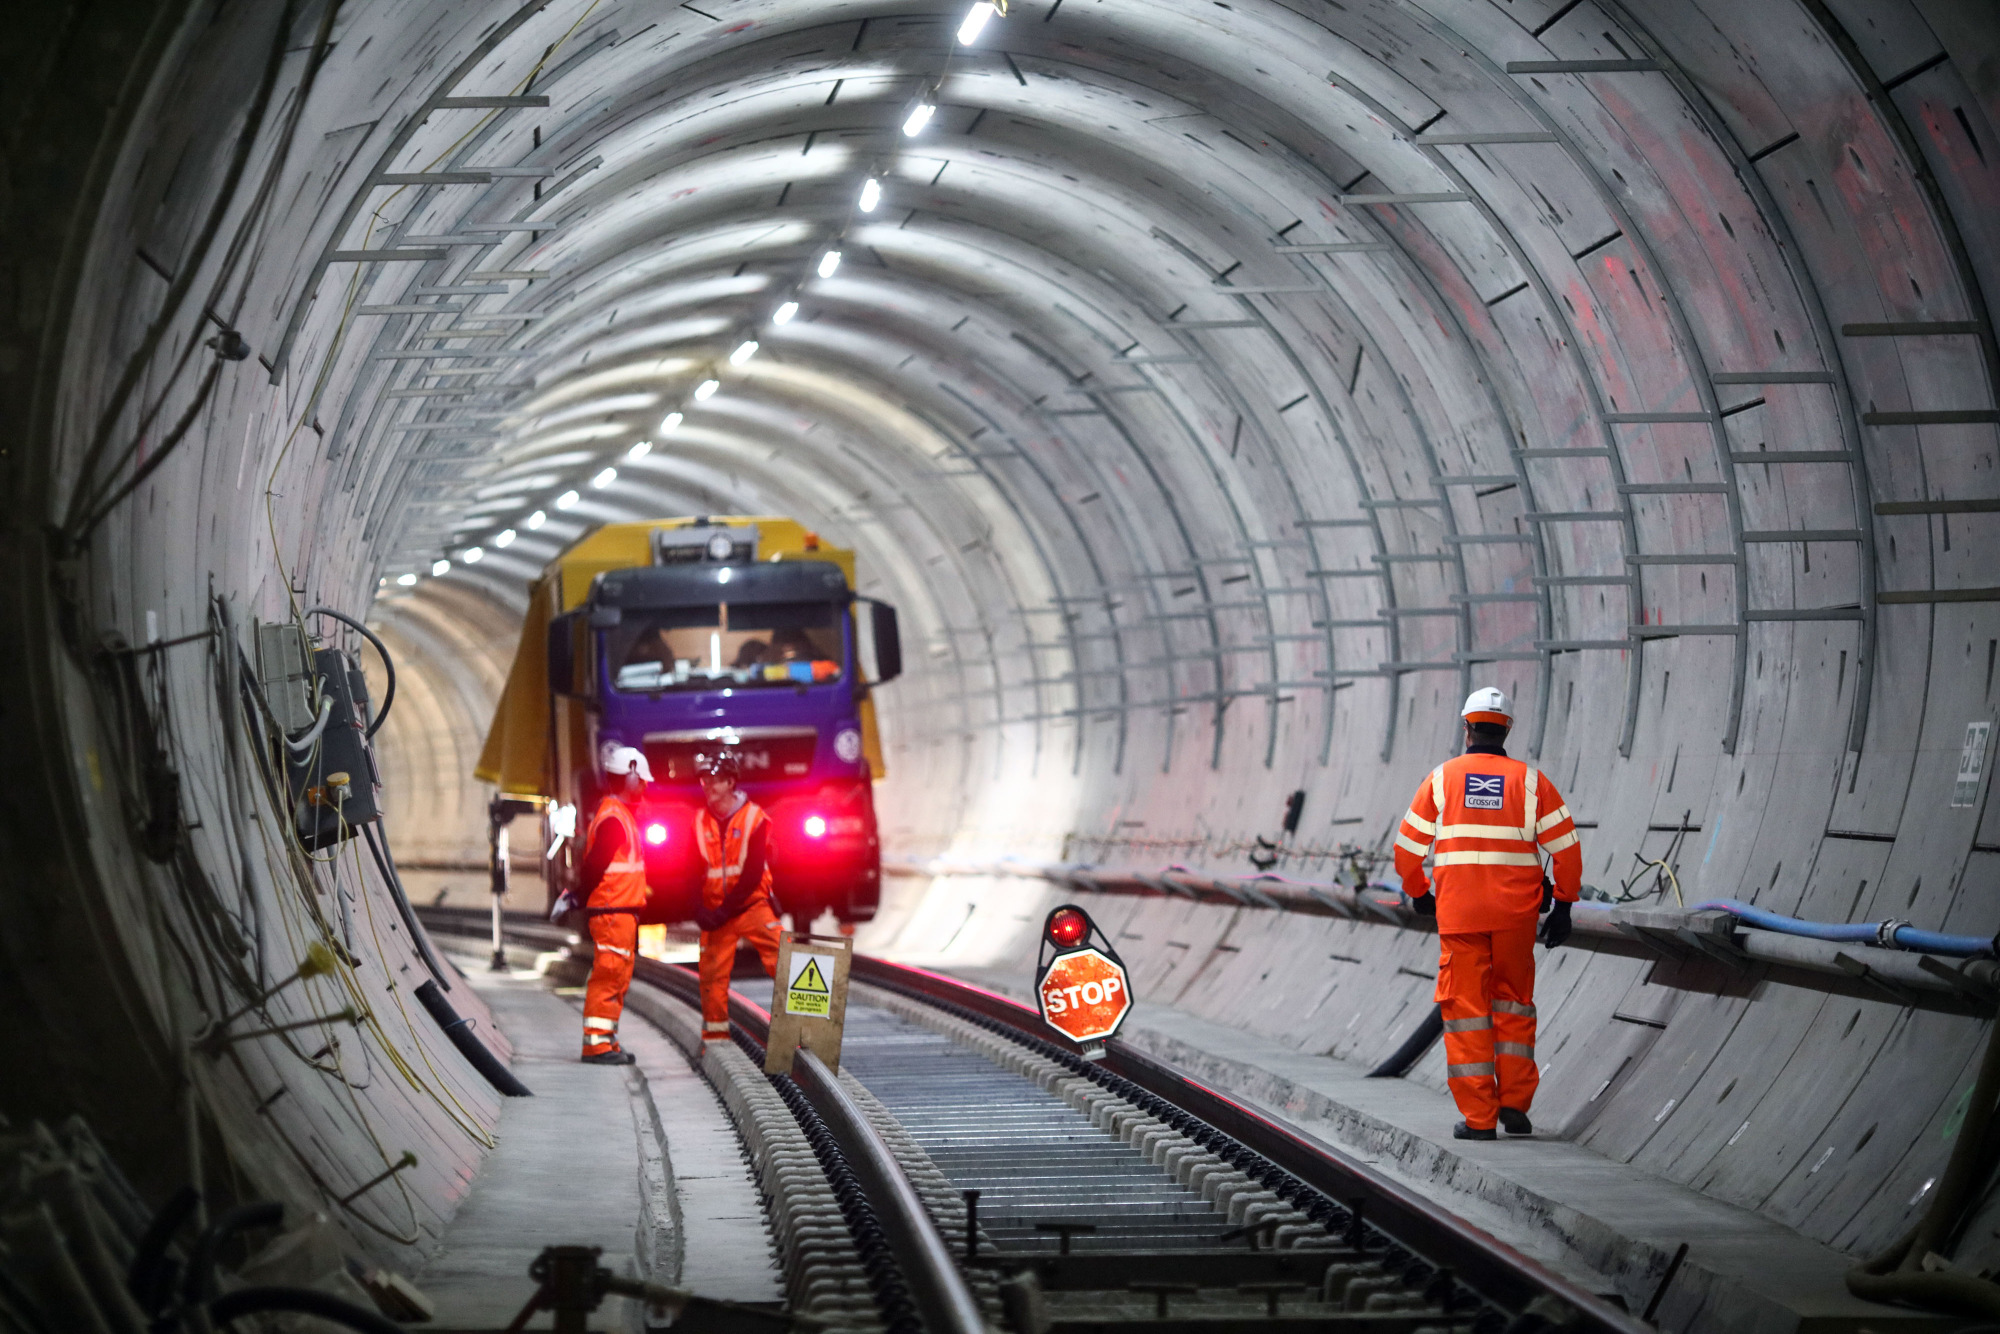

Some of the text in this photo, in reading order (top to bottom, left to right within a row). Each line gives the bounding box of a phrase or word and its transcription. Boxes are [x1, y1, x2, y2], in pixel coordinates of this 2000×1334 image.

[1468, 797, 1500, 806] Crossrail
[790, 992, 828, 1003] CAUTION
[1047, 977, 1121, 1013] STOP
